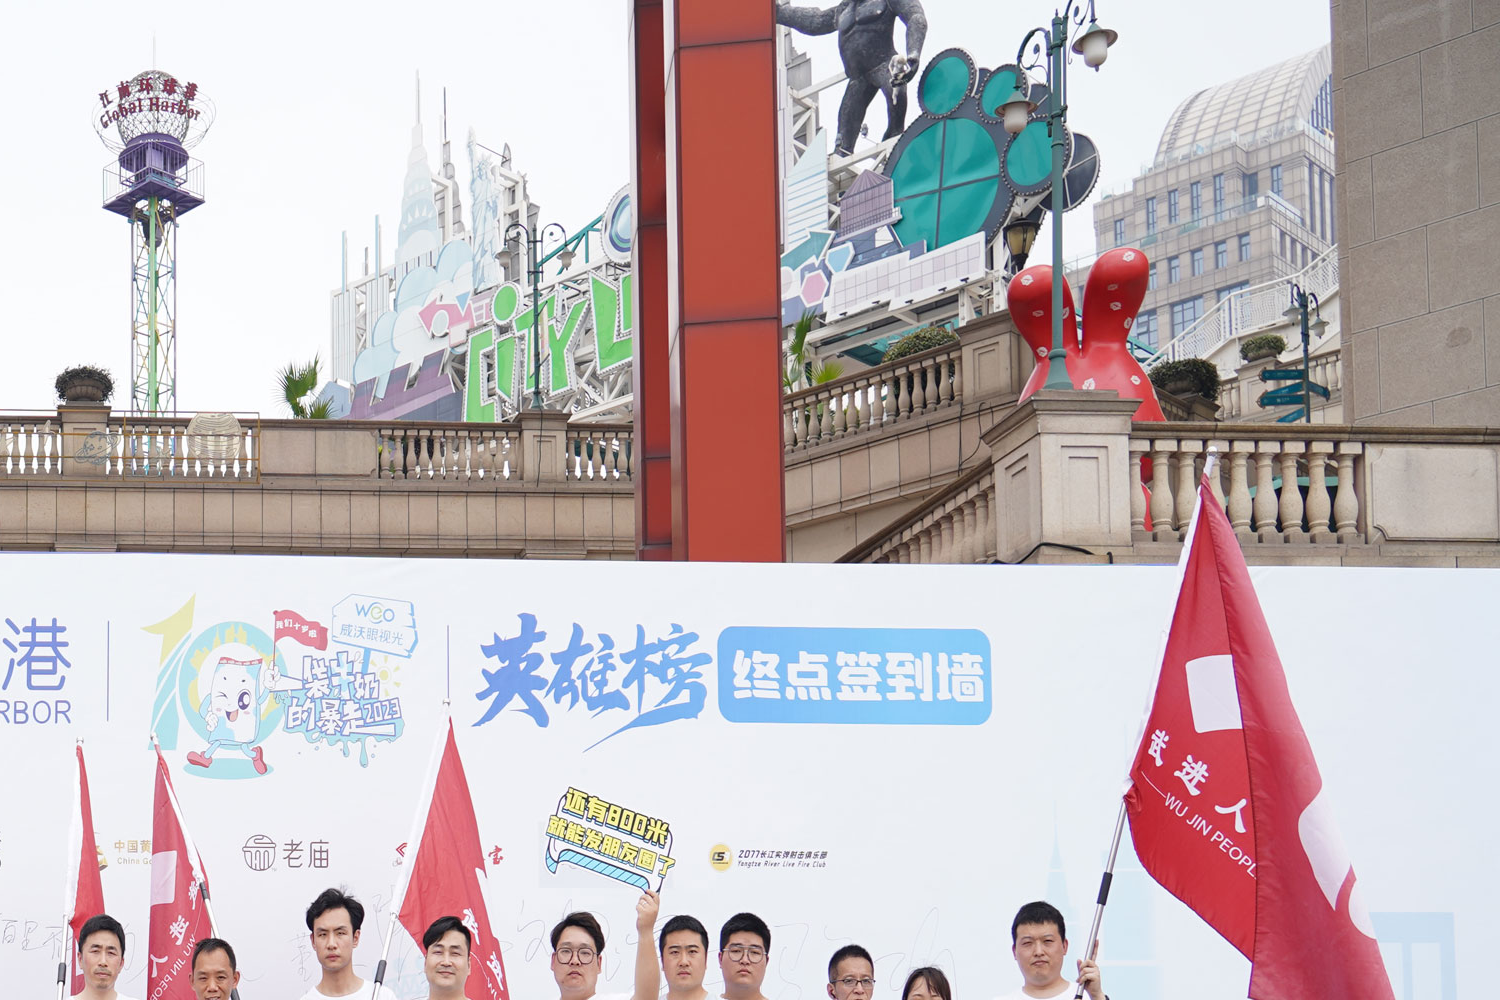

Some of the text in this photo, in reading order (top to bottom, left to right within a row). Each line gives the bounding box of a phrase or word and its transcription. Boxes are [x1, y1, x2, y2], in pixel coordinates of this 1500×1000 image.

[149, 97, 200, 120] Harbor
[275, 618, 317, 638] 我们十岁啦
[340, 623, 404, 646] 威沃眼视光
[471, 612, 713, 753] 英雄榜
[733, 650, 985, 703] 终点签到墙
[1148, 729, 1247, 833] 武进人
[562, 786, 670, 849] 还有800米
[1164, 792, 1257, 880] WU JIN PEOPL
[117, 857, 140, 865] China
[282, 839, 329, 869] 老庙
[546, 814, 676, 878] 就能发朋友圈了
